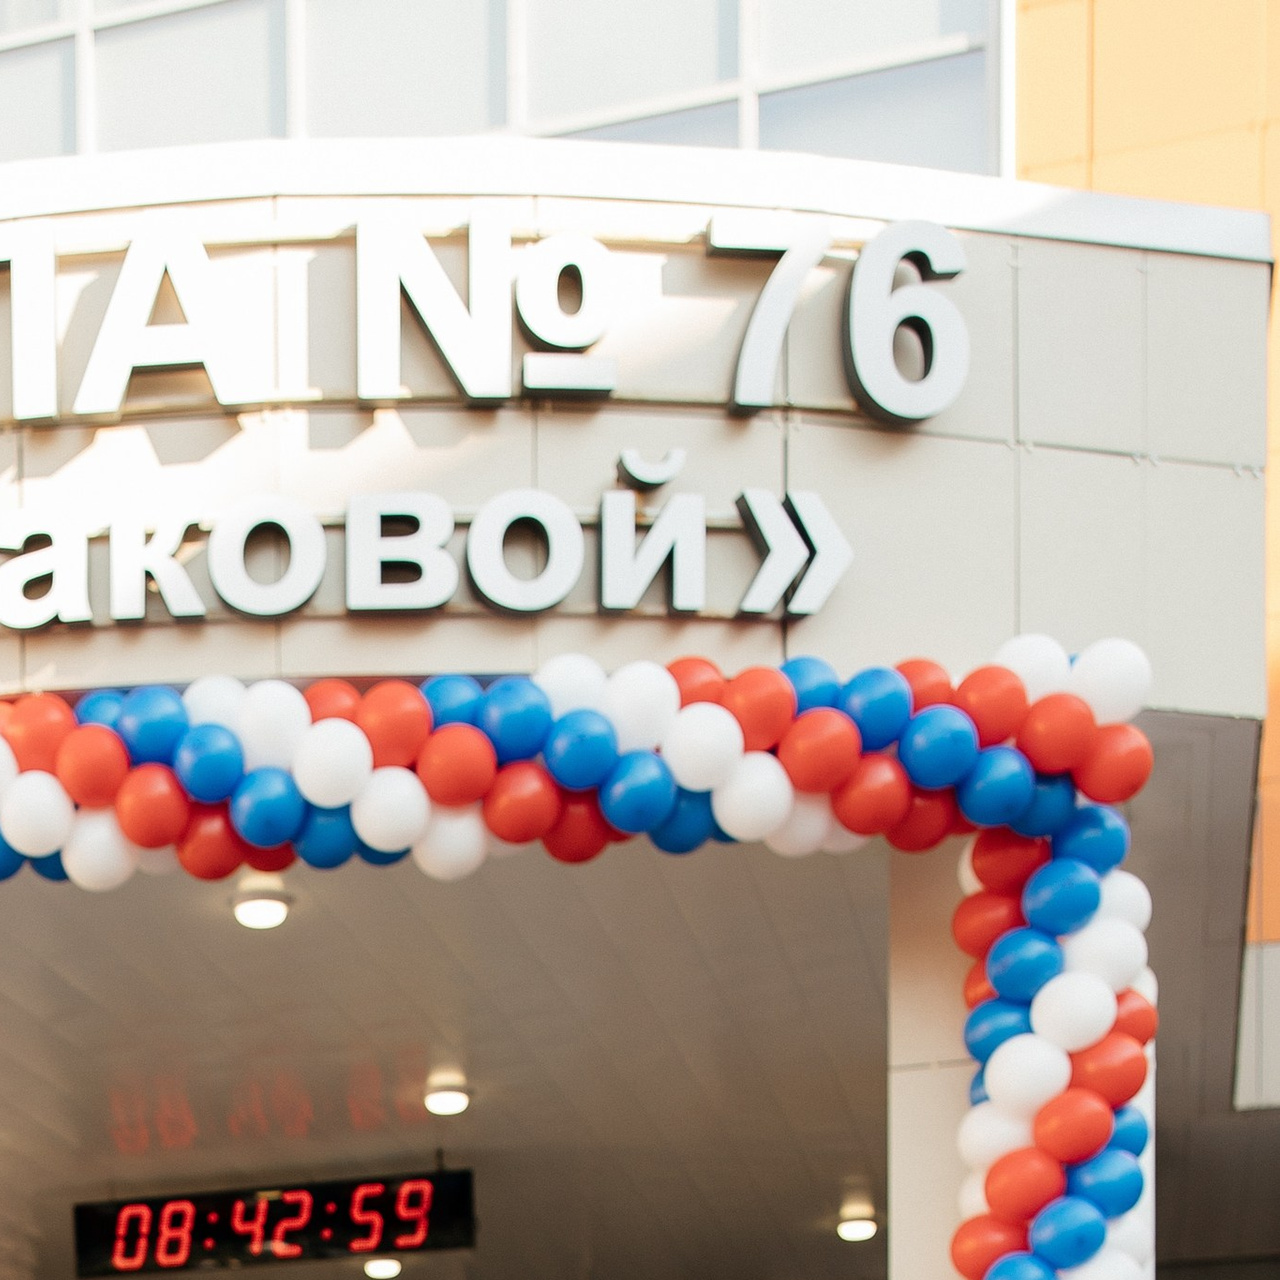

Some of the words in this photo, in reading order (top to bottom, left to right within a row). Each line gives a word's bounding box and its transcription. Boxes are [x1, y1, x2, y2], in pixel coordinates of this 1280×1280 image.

[356, 215, 617, 399] №
[707, 217, 969, 424] 76
[111, 1178, 434, 1271] 08:42:59
